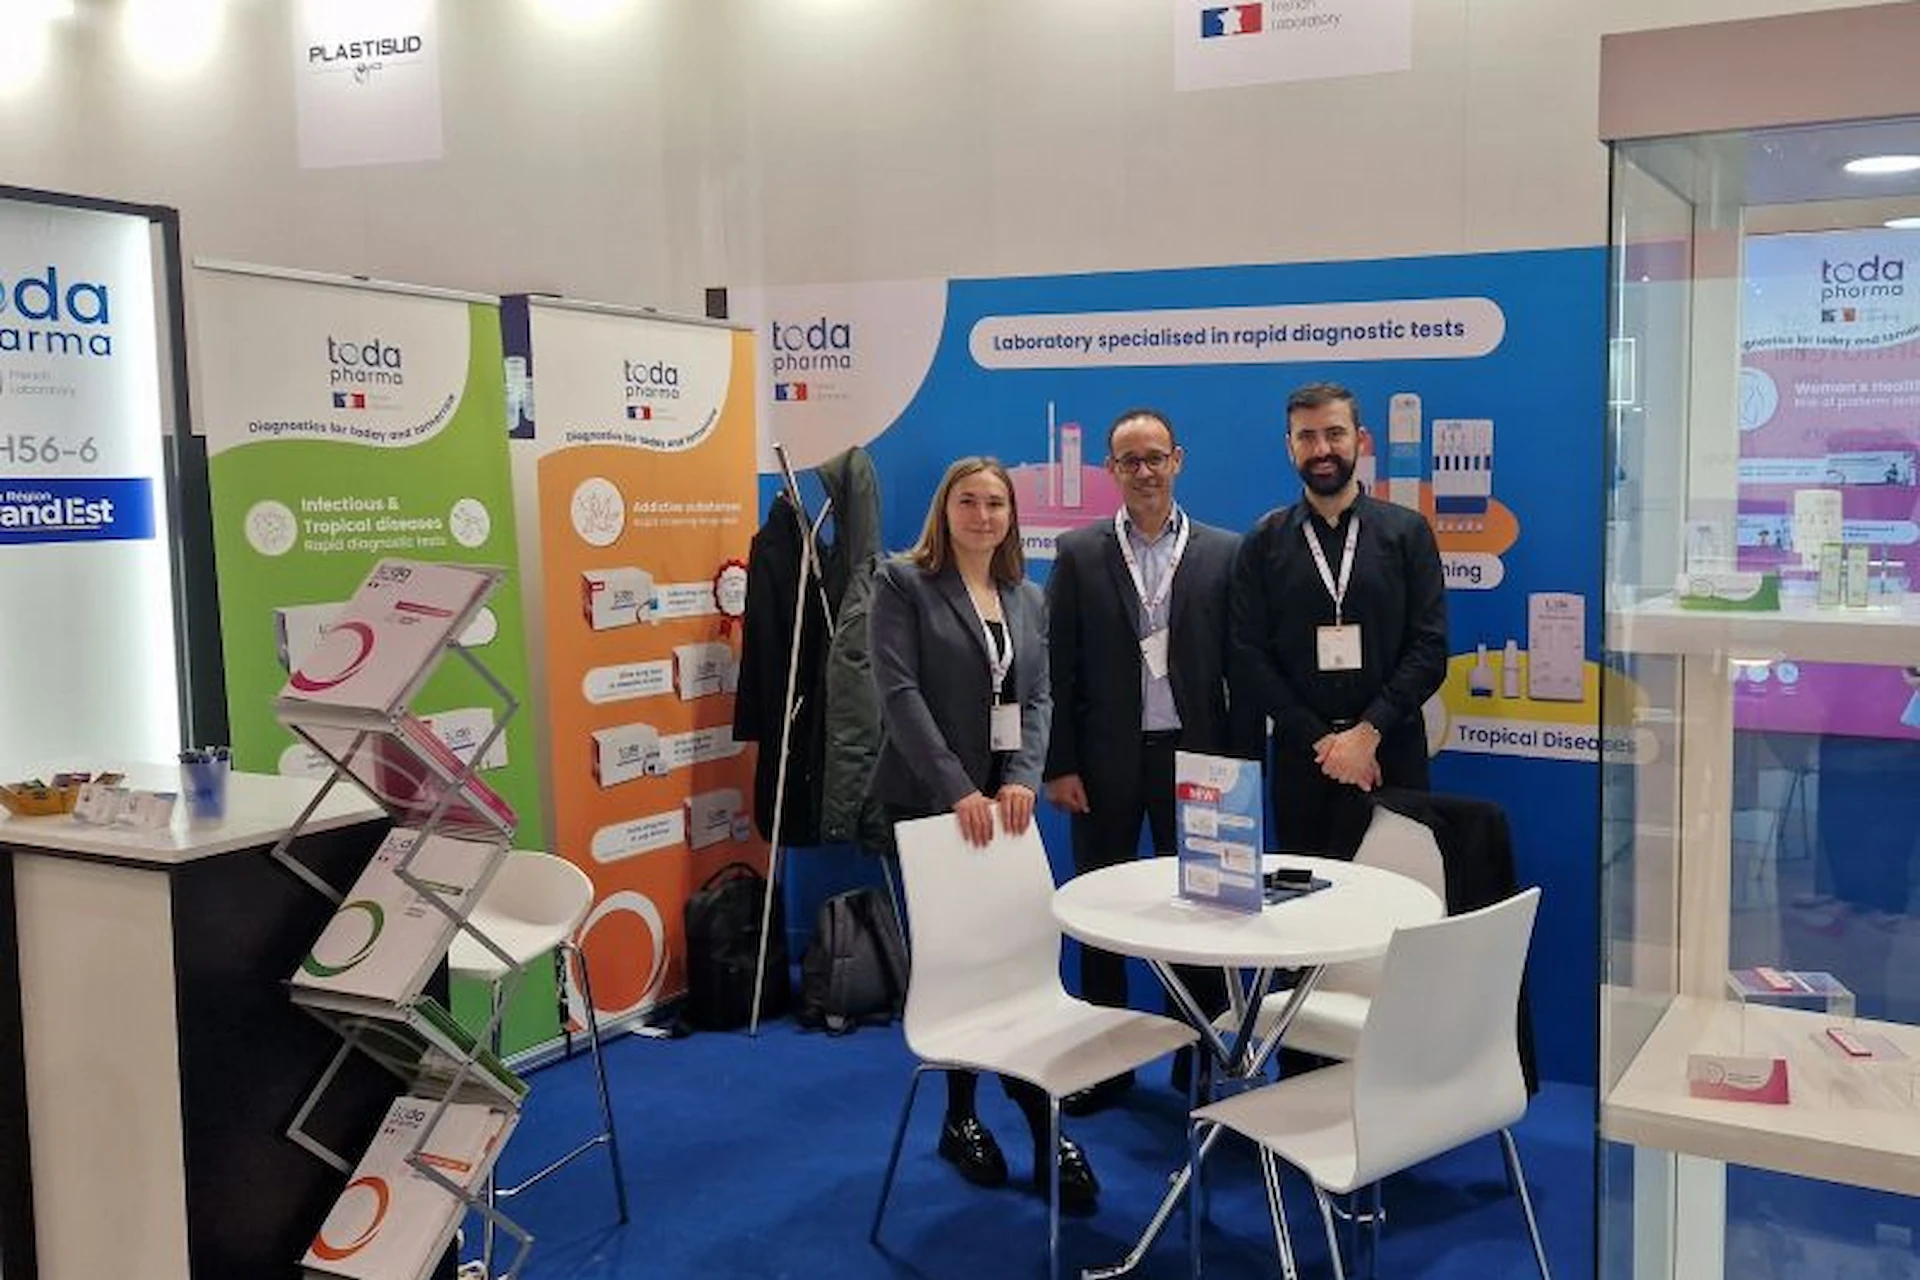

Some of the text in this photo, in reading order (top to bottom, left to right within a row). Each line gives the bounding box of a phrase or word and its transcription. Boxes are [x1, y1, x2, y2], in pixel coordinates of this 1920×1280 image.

[308, 35, 423, 62] PLASTISUD
[1822, 253, 1905, 284] toda
[0, 266, 109, 324] da
[1821, 285, 1905, 303] pharma
[772, 316, 850, 351] toda
[994, 319, 1465, 353] Laboratory specialised in rapid diagnostic tests
[327, 334, 402, 368] toda
[330, 367, 403, 386] pharma
[624, 360, 679, 386] toda
[773, 354, 850, 376] pharma
[626, 386, 680, 400] pharma
[249, 420, 327, 435] Diagnostics
[330, 423, 348, 434] for
[350, 426, 386, 442] today
[390, 428, 412, 440] and
[301, 496, 399, 512] Infectious &
[304, 516, 443, 537] Tropical diseases
[304, 538, 345, 554] Rapid
[346, 536, 415, 553] diagnostic
[1457, 725, 1537, 749] Tropical
